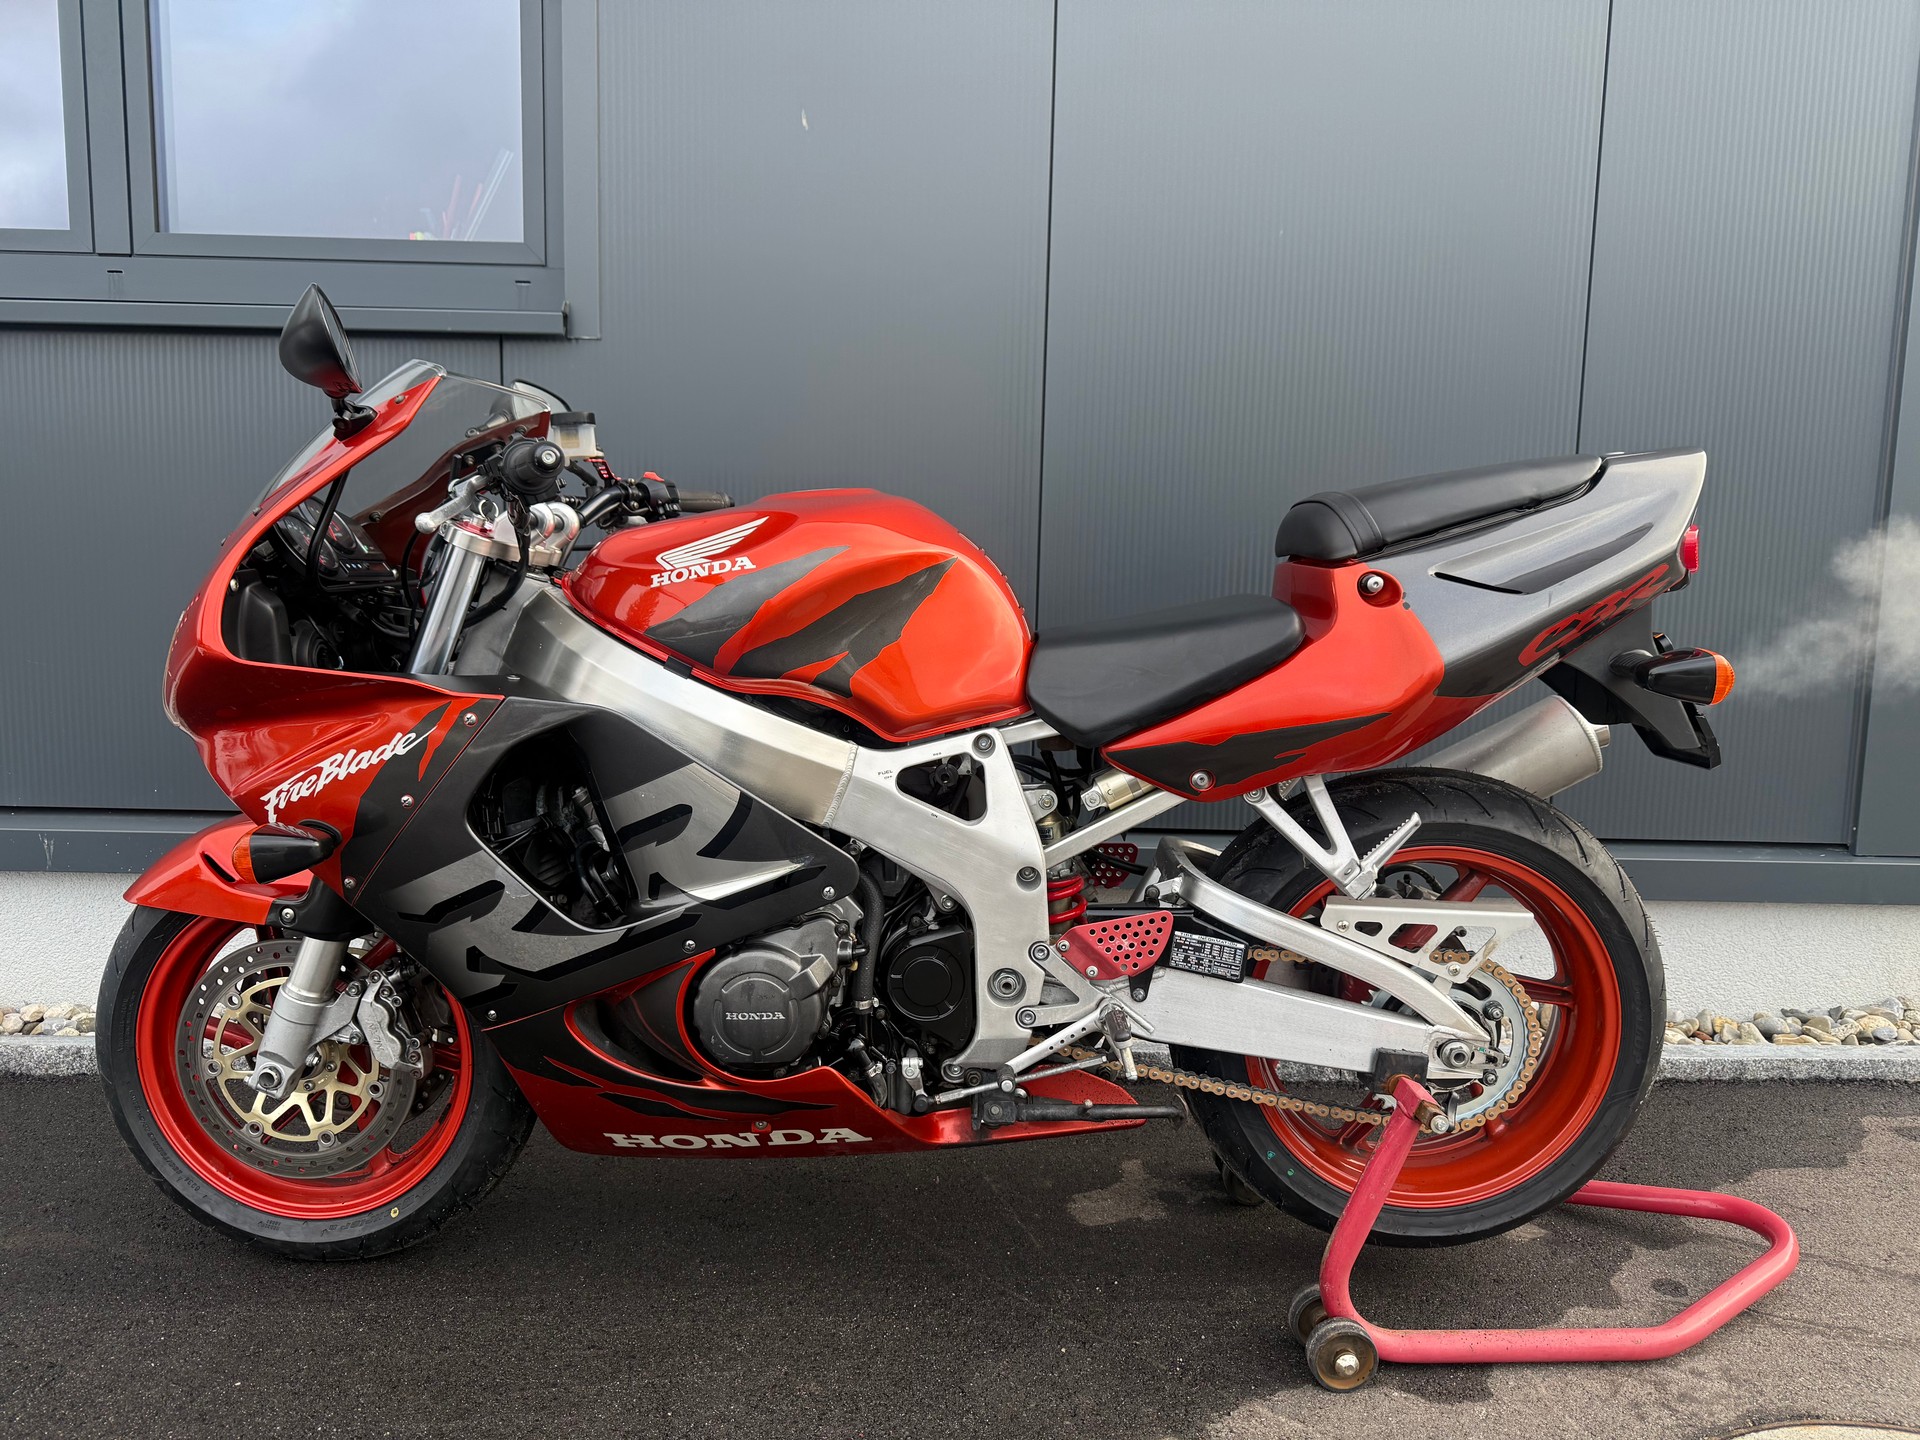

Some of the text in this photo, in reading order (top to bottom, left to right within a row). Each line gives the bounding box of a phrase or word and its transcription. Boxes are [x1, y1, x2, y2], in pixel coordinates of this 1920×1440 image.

[650, 556, 757, 589] HONDA
[1518, 563, 1672, 667] CBR
[259, 724, 439, 824] FireBlade
[725, 1011, 786, 1021] HONDA
[603, 1127, 873, 1149] HONDA
